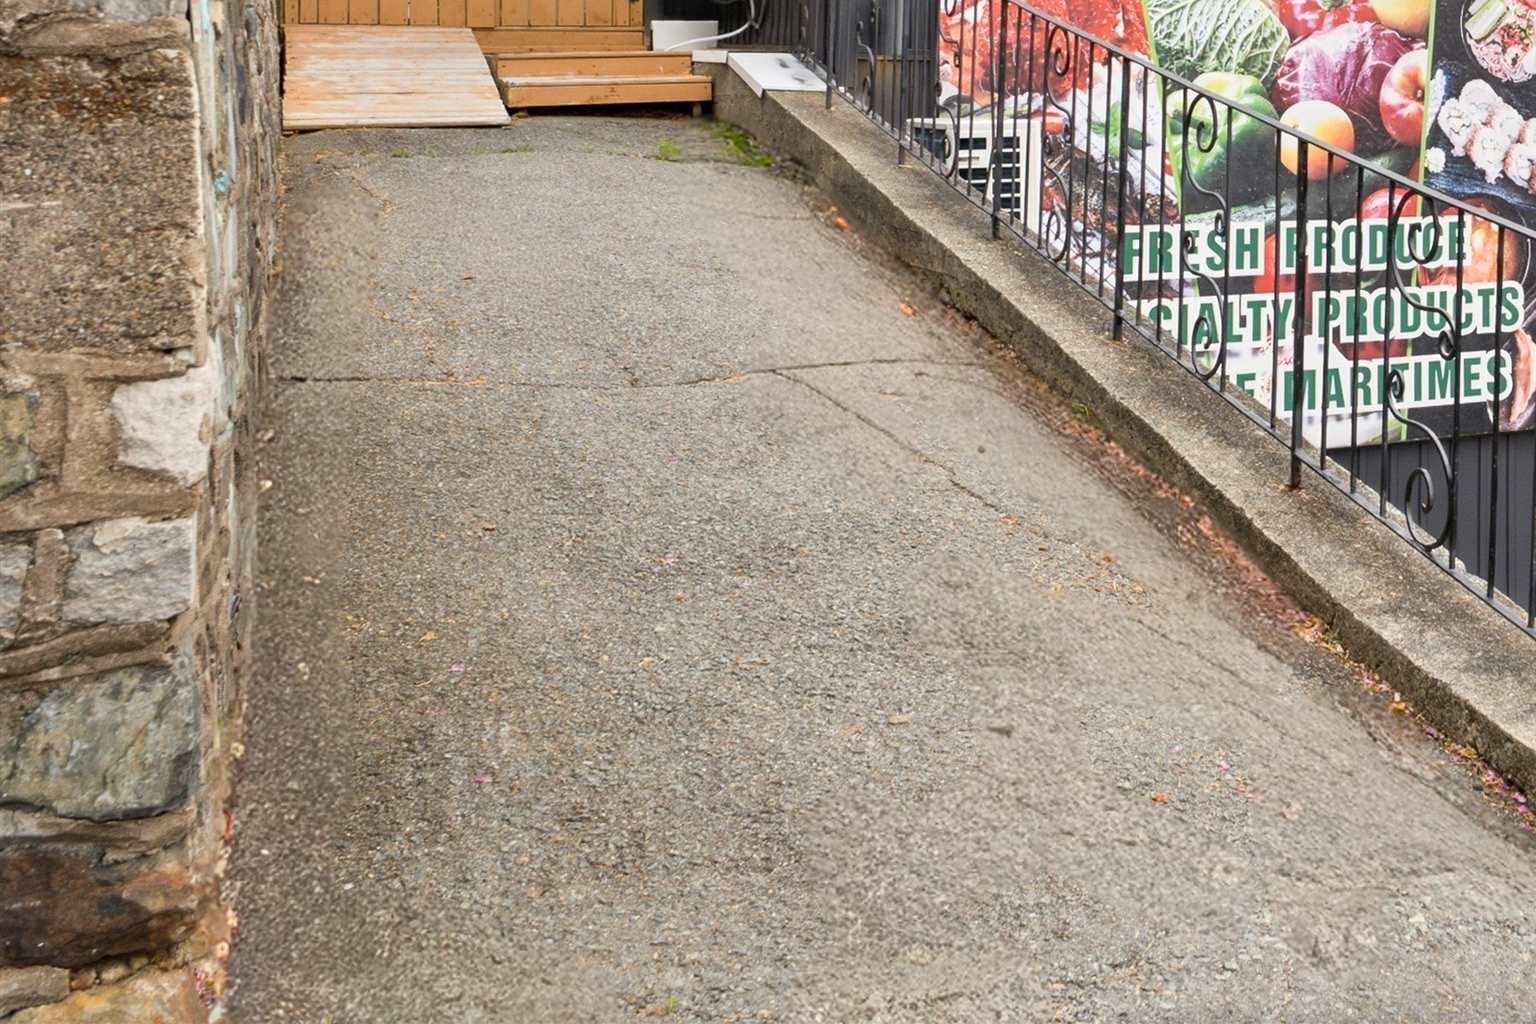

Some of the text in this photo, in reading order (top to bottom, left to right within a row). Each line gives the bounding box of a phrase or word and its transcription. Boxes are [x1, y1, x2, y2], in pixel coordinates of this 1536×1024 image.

[1123, 221, 1466, 275] FRESH PRODUCE
[1149, 286, 1520, 348] IALTY PRODUCTS
[1284, 357, 1508, 411] MARITIMES
